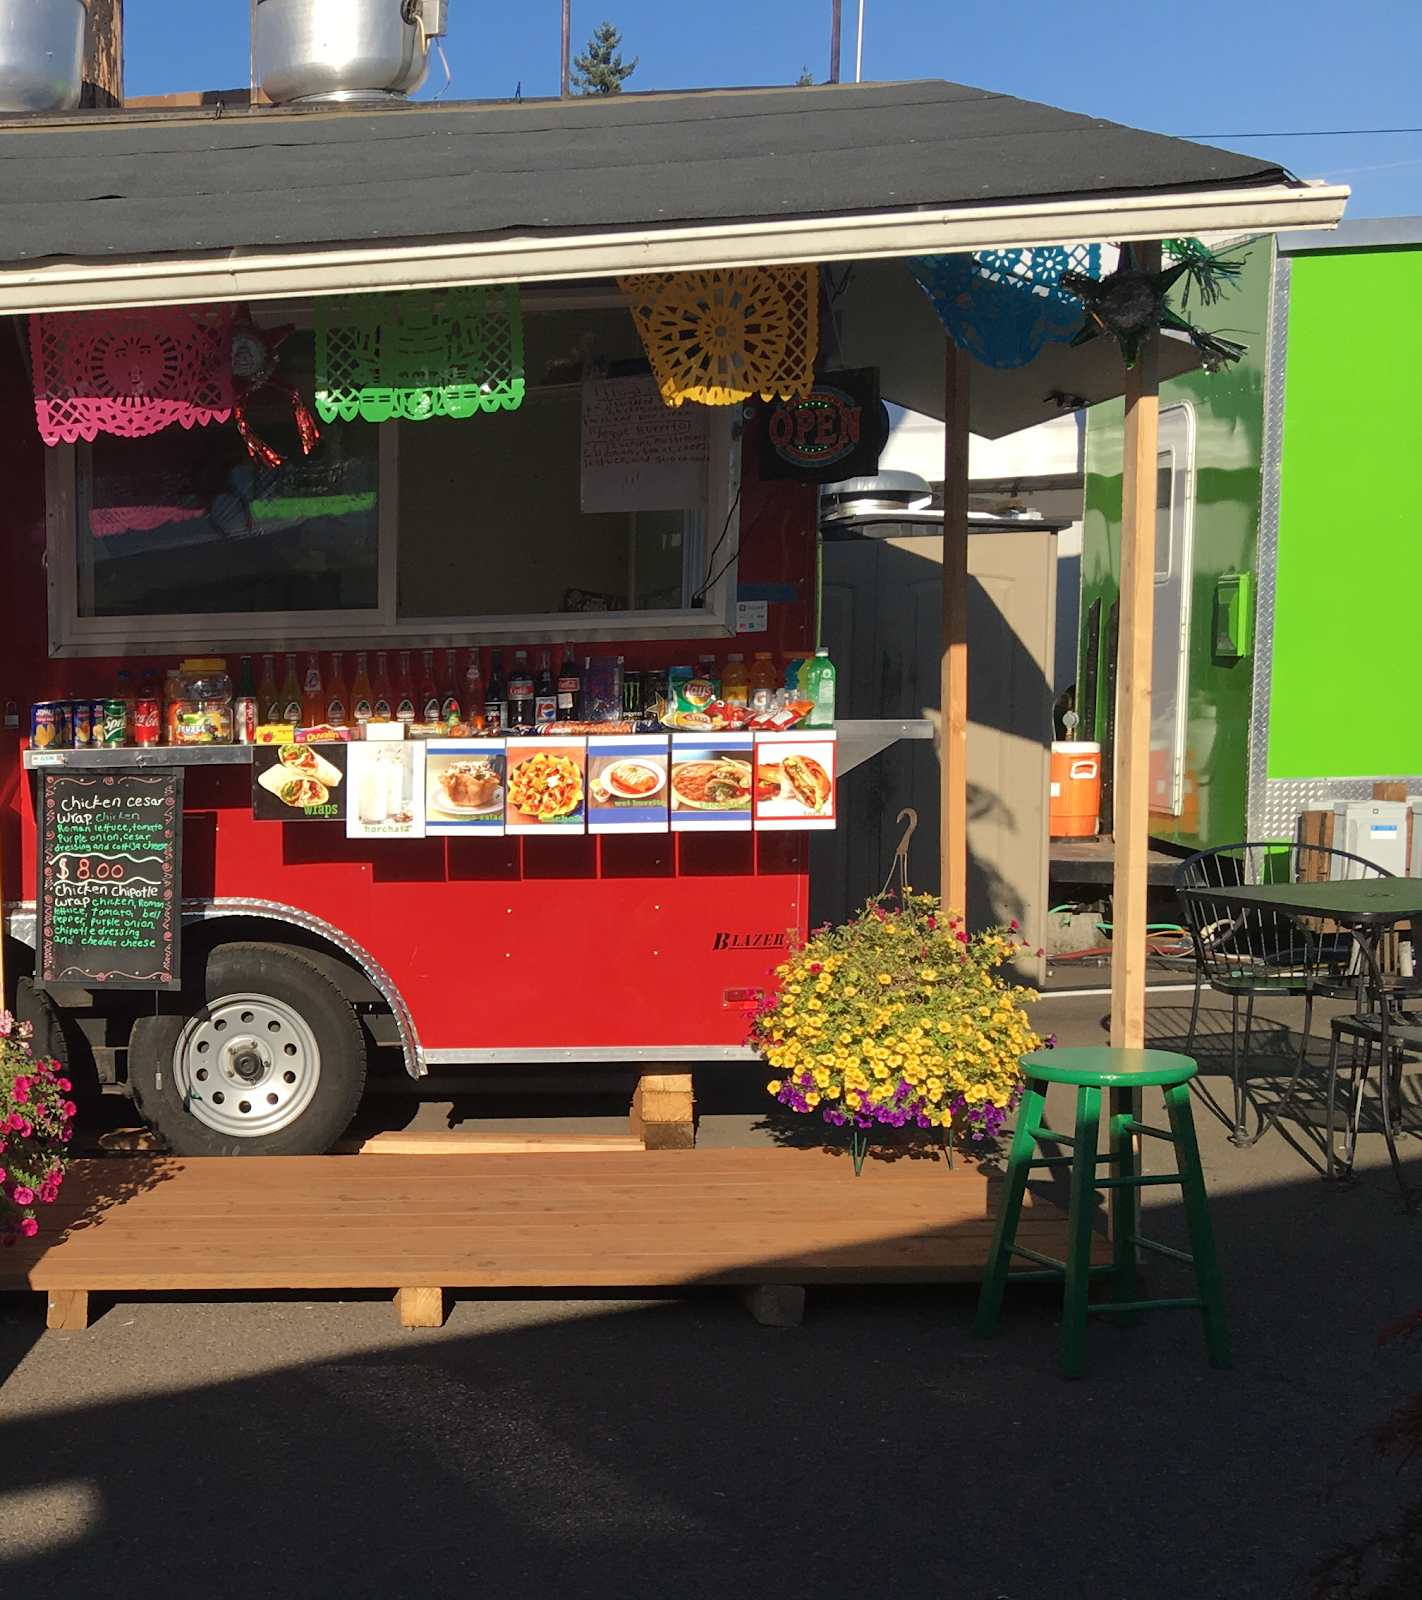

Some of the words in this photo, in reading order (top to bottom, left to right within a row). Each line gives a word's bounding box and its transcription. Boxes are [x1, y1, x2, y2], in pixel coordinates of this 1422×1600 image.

[769, 407, 862, 446] OPEN
[509, 686, 530, 696] Coke
[126, 796, 165, 807] cesar
[632, 799, 666, 807] burrito
[303, 803, 338, 818] wraps
[803, 809, 827, 817] torta
[479, 813, 504, 822] salad
[541, 814, 581, 823] nachos
[57, 823, 91, 833] Roman
[364, 824, 410, 834] horchata
[54, 843, 92, 852] dressing
[92, 843, 110, 851] and
[77, 858, 125, 879] 8.00
[142, 908, 162, 920] bell
[98, 926, 140, 940] dressing
[53, 935, 74, 945] and
[81, 936, 117, 947] cheddar
[120, 939, 156, 948] cheese
[712, 932, 786, 950] BLAZER
